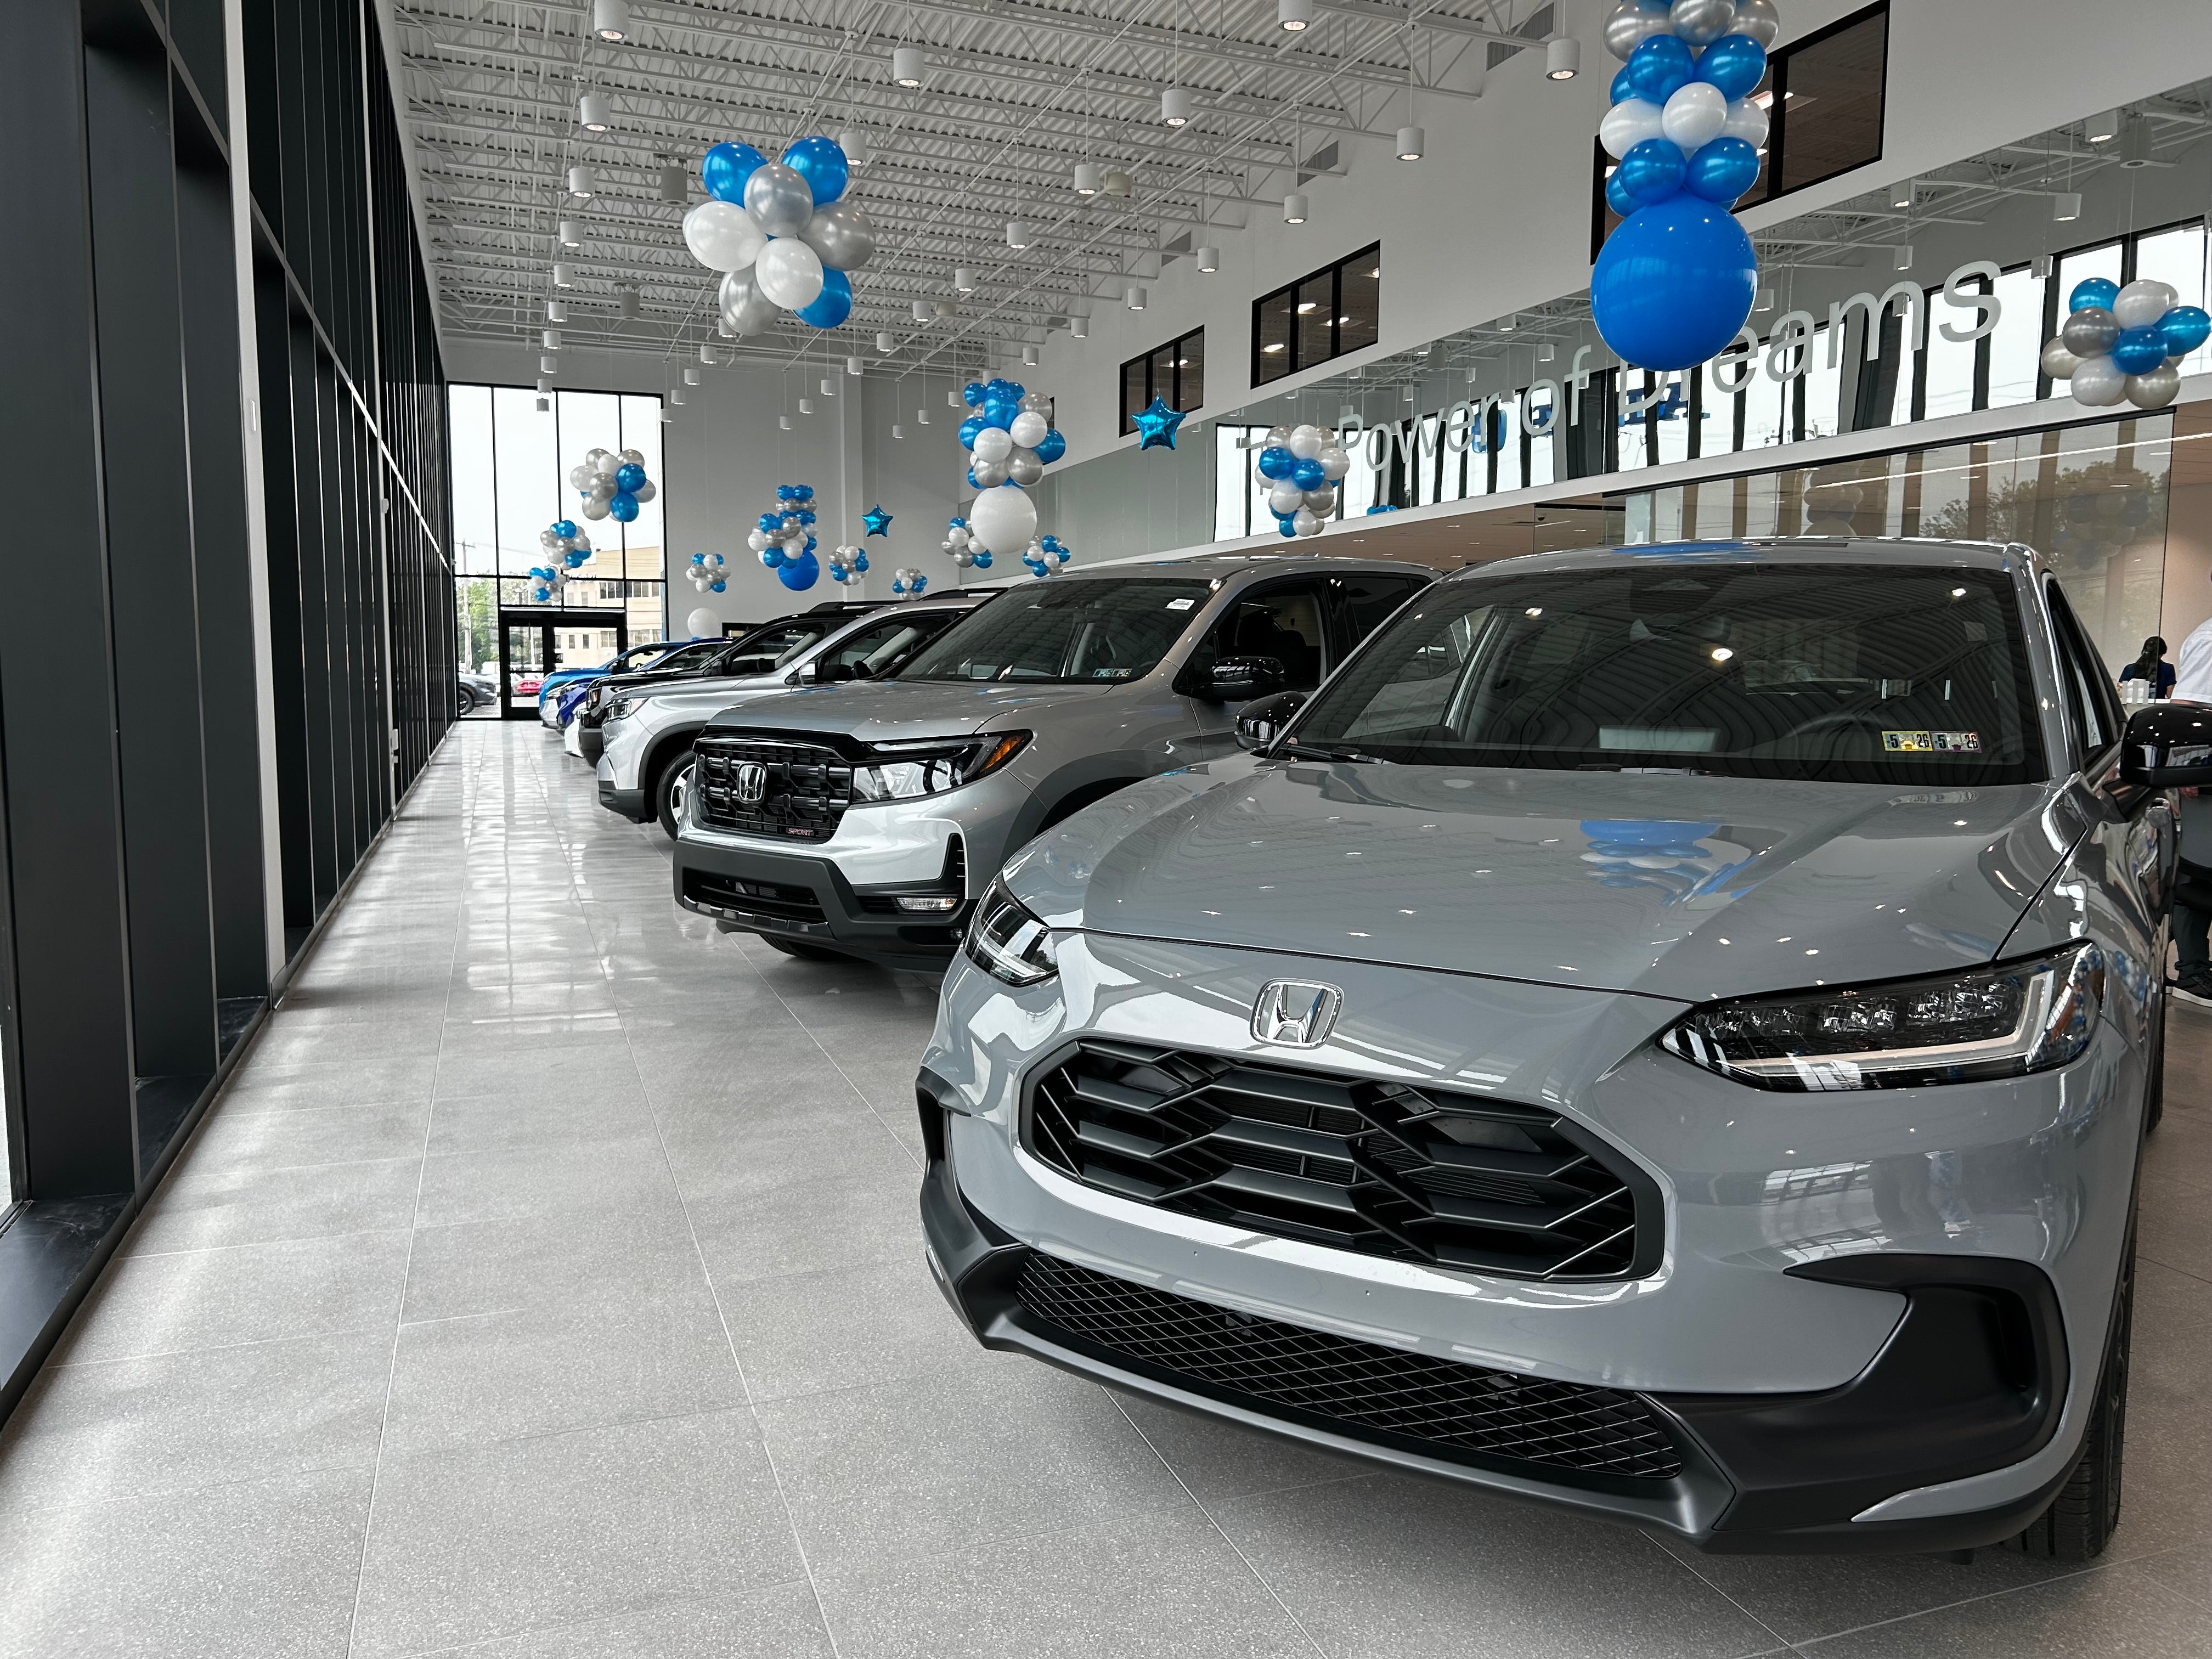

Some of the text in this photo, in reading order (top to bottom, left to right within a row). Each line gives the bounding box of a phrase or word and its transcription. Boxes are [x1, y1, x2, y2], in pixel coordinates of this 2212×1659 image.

[1338, 392, 1500, 471] Power
[1522, 344, 1592, 436] of
[1889, 733, 1930, 748] 5 26
[1937, 735, 1947, 749] 5
